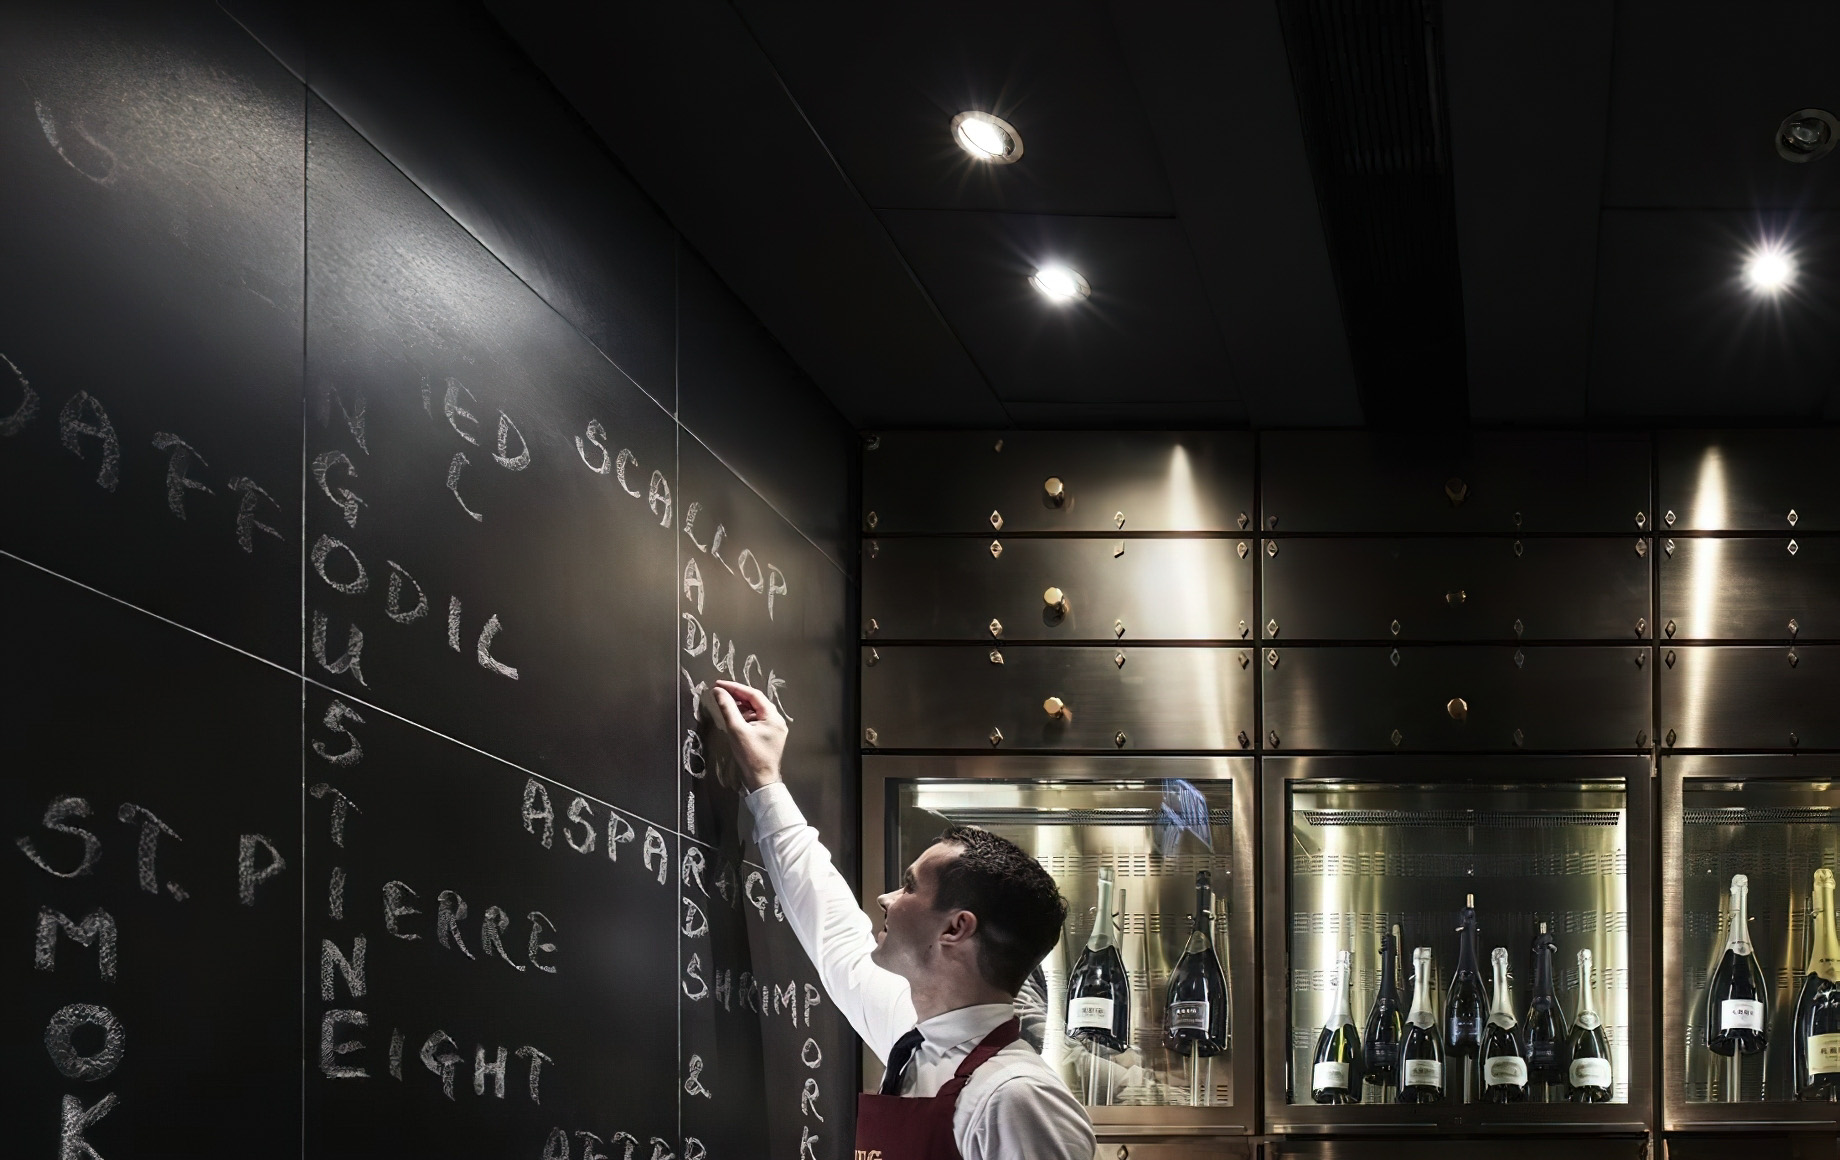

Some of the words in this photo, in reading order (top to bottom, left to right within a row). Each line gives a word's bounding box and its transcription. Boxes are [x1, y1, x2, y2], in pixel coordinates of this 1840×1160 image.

[574, 417, 788, 622] SCALLOP
[682, 611, 794, 723] DUCK
[681, 952, 822, 1029] SHRIMP
